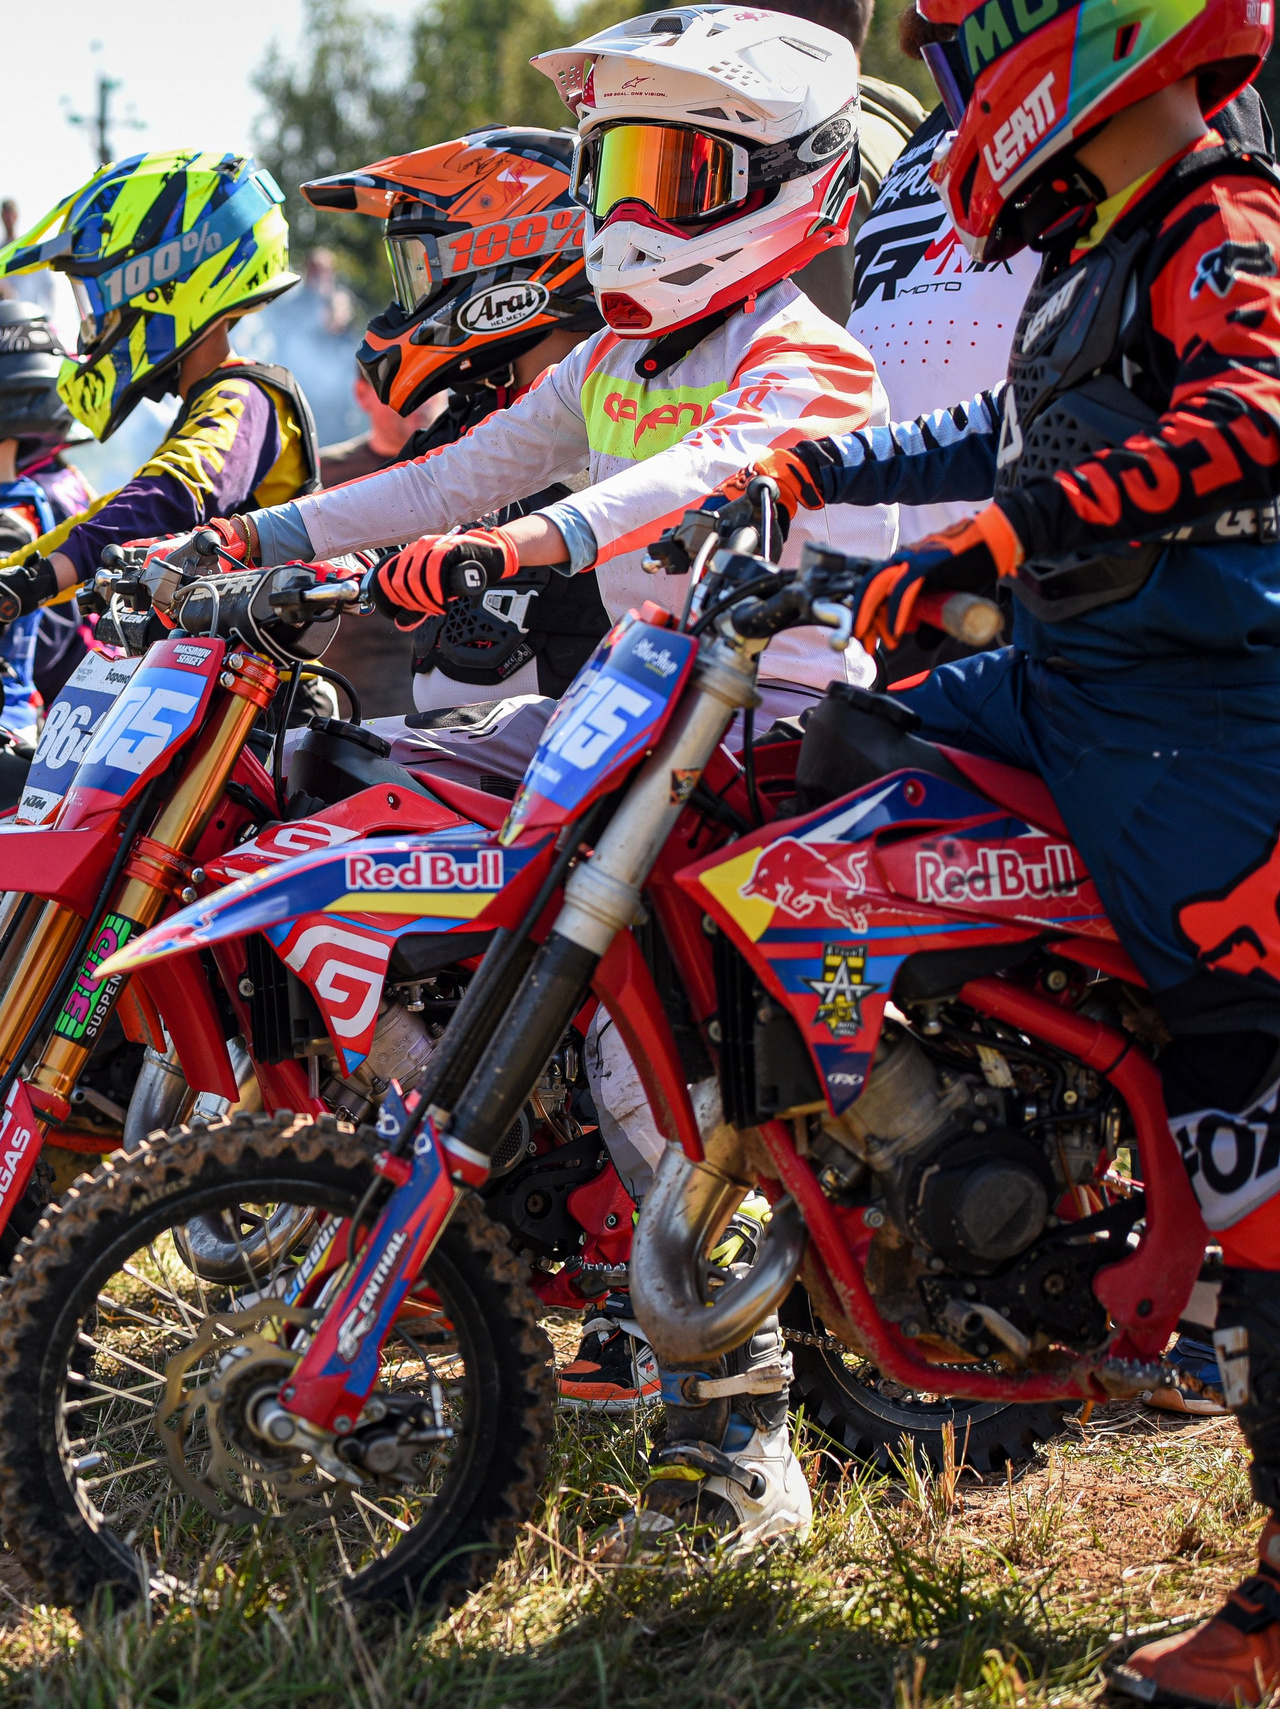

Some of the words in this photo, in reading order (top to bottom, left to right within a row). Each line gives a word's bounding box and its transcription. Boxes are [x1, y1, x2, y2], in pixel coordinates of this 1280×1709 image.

[983, 71, 1056, 182] LEATT
[448, 210, 586, 273] 100%
[105, 221, 221, 306] 100%
[468, 285, 537, 328] Arai
[898, 281, 962, 298] MOTO
[176, 653, 206, 667] SERGEY
[23, 794, 47, 810] KTM
[347, 852, 421, 888] Red
[428, 852, 502, 888] Bull
[917, 849, 993, 902] Red
[997, 846, 1077, 899] Bull
